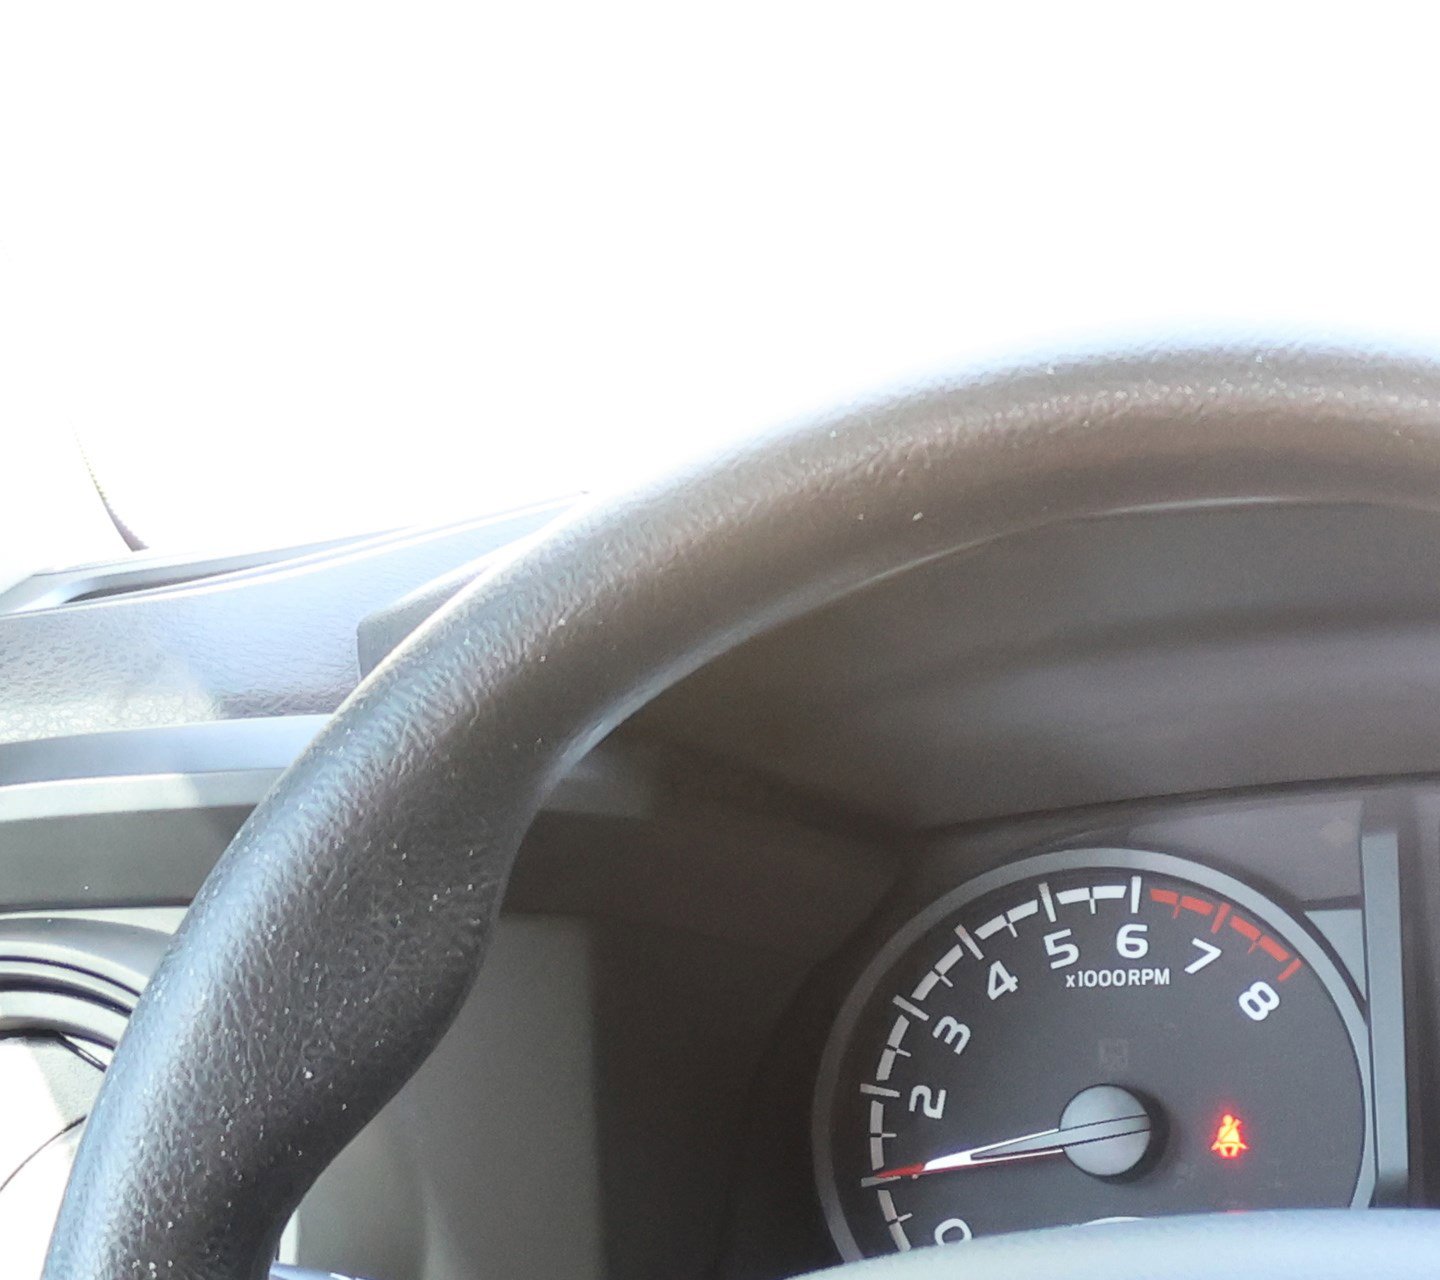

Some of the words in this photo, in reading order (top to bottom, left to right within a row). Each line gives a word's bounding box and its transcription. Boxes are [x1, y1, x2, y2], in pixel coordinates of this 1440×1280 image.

[1044, 930, 1079, 970] 5
[1115, 923, 1149, 959] 6
[1188, 940, 1222, 978] 7
[985, 962, 1020, 1001] 4
[1238, 981, 1280, 1022] 8
[932, 1015, 972, 1055] 3
[909, 1085, 946, 1120] 2
